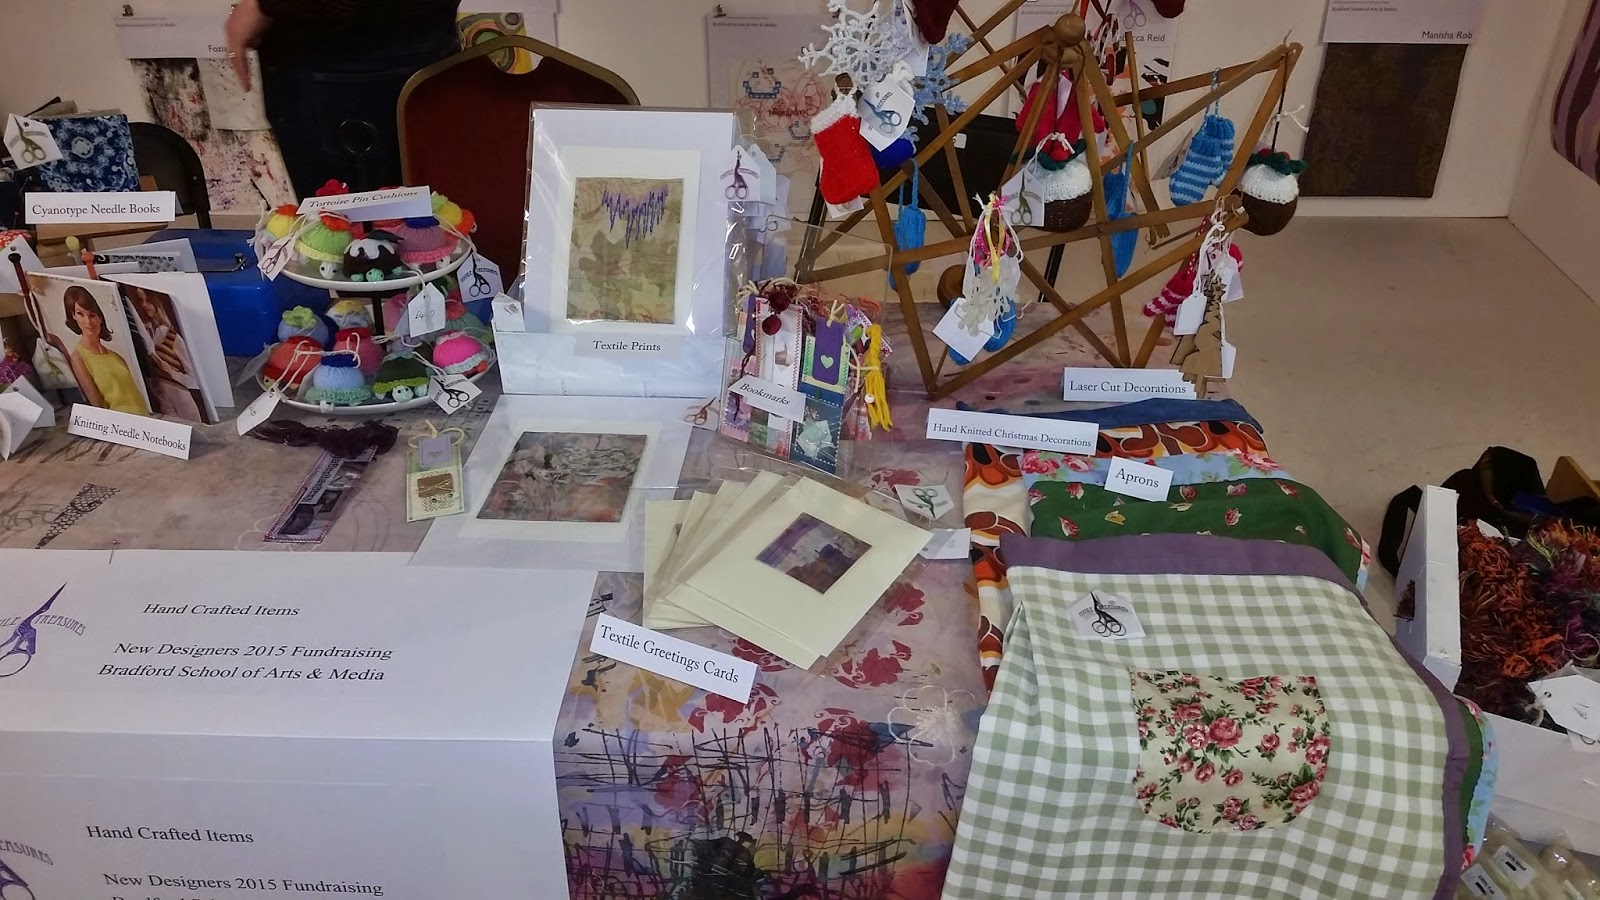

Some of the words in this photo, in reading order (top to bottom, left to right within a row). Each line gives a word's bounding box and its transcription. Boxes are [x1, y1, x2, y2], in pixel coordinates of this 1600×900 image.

[1147, 33, 1166, 42] Reid
[1421, 30, 1454, 39] Manisha
[309, 199, 350, 208] Tortoise
[352, 196, 369, 204] Pin
[371, 191, 419, 201] Cushions
[32, 204, 88, 218] Cyanotype
[91, 203, 126, 214] Needle
[129, 203, 160, 214] Books
[592, 340, 628, 350] Textile
[631, 341, 661, 351] Prints
[740, 383, 791, 406] Bookmarks
[1069, 380, 1098, 392] Laser
[1100, 381, 1121, 392] Cut
[1124, 381, 1187, 394] Decorations
[73, 415, 109, 435] Knitting
[111, 423, 140, 440] Needle
[142, 430, 186, 451] Notebooks
[933, 422, 957, 434] Hand
[959, 425, 992, 437] Knitted
[994, 428, 1038, 442] Christmas
[1040, 433, 1092, 448] Decorations
[1115, 467, 1160, 488] Aprons
[142, 603, 189, 615] Hand
[190, 603, 251, 616] Crafted
[254, 604, 301, 617] Items
[34, 614, 87, 637] TREASURES
[113, 642, 155, 655] New
[157, 643, 240, 659] Designers
[242, 644, 288, 657] 2015
[290, 645, 394, 661] Fundraising
[600, 624, 640, 650] Textile
[643, 640, 700, 672] Greetings
[703, 660, 740, 684] Cards
[98, 664, 175, 678] Bradford
[177, 665, 238, 679] School
[241, 665, 265, 679] of
[263, 667, 302, 680] Arts
[306, 668, 325, 681] &
[327, 668, 385, 682] Media
[86, 825, 134, 840] Hand
[137, 826, 202, 842] Crafted
[205, 829, 254, 844] Items
[103, 873, 143, 886] New
[149, 874, 231, 890] Designers
[236, 877, 278, 891] 2015
[282, 879, 384, 896] Fundraising
